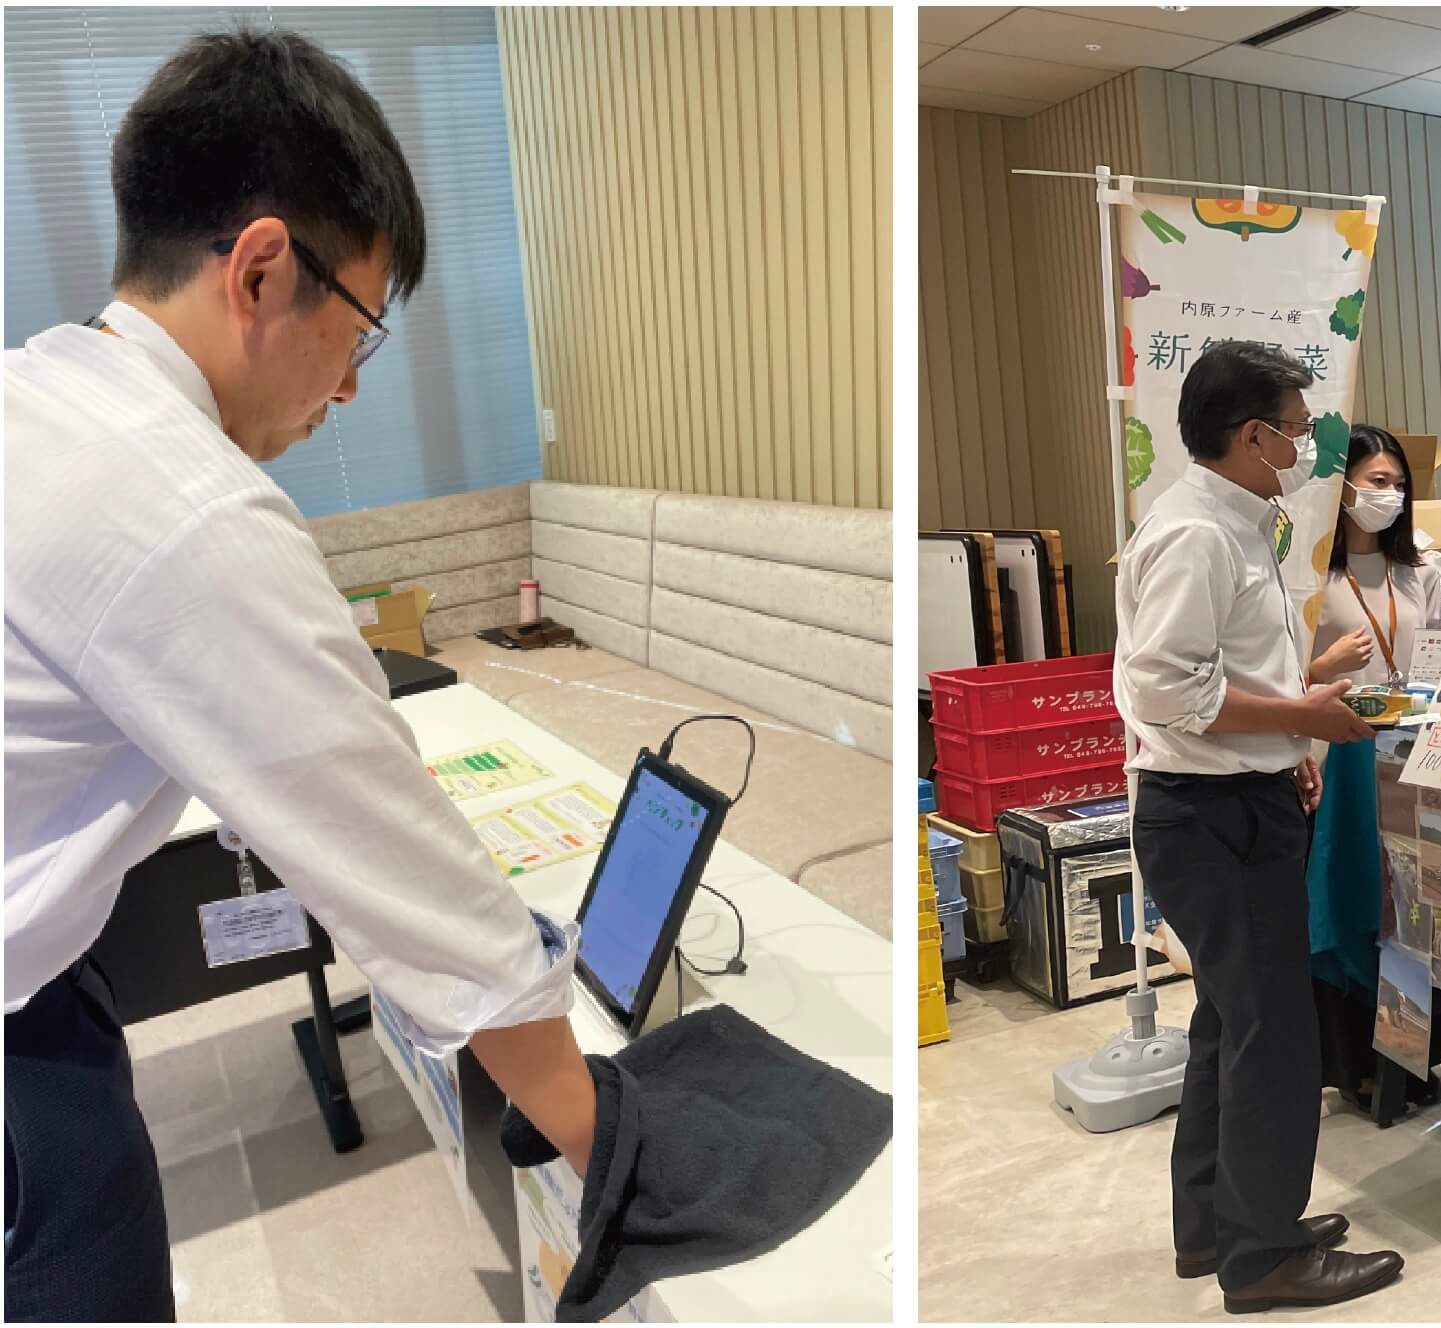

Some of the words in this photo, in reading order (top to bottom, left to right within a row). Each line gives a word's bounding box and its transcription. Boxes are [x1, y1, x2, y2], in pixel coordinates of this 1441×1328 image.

[1181, 299, 1304, 325] 内原ファーム産
[1146, 329, 1331, 382] 新菜
